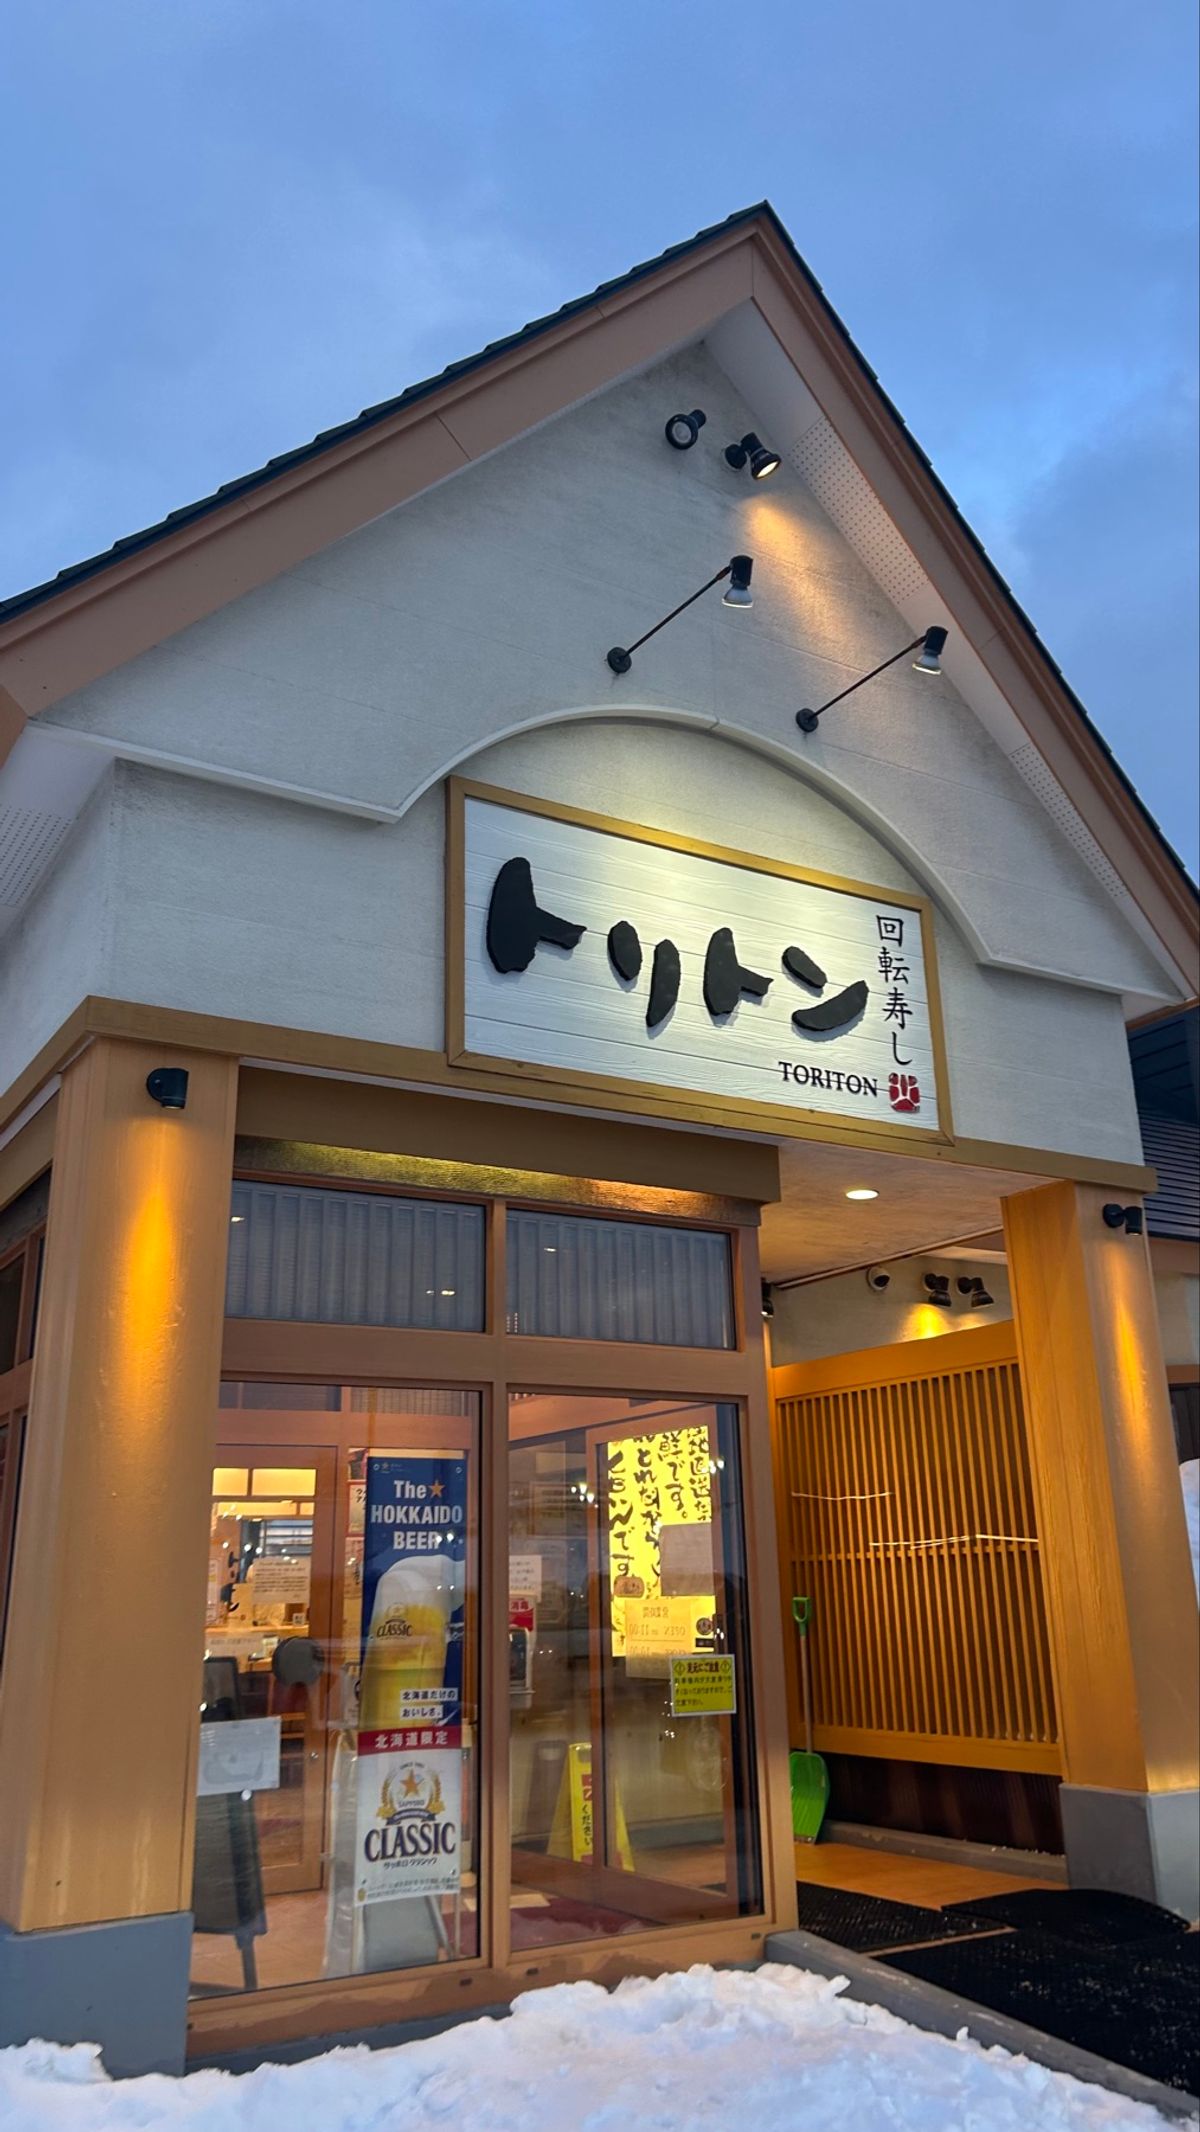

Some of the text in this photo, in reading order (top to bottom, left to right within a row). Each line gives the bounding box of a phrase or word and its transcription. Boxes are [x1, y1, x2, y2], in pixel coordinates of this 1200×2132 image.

[486, 857, 870, 1030] トリトン
[876, 914, 914, 1066] 回転寿し
[778, 1061, 879, 1097] TORITON
[393, 1480, 427, 1499] The
[370, 1504, 463, 1524] HOKKAIDO
[393, 1531, 441, 1550] BEER
[402, 1689, 456, 1701] 北海道だけの
[375, 1731, 448, 1749] 北海道限定
[364, 1822, 456, 1863] CLASSIC
